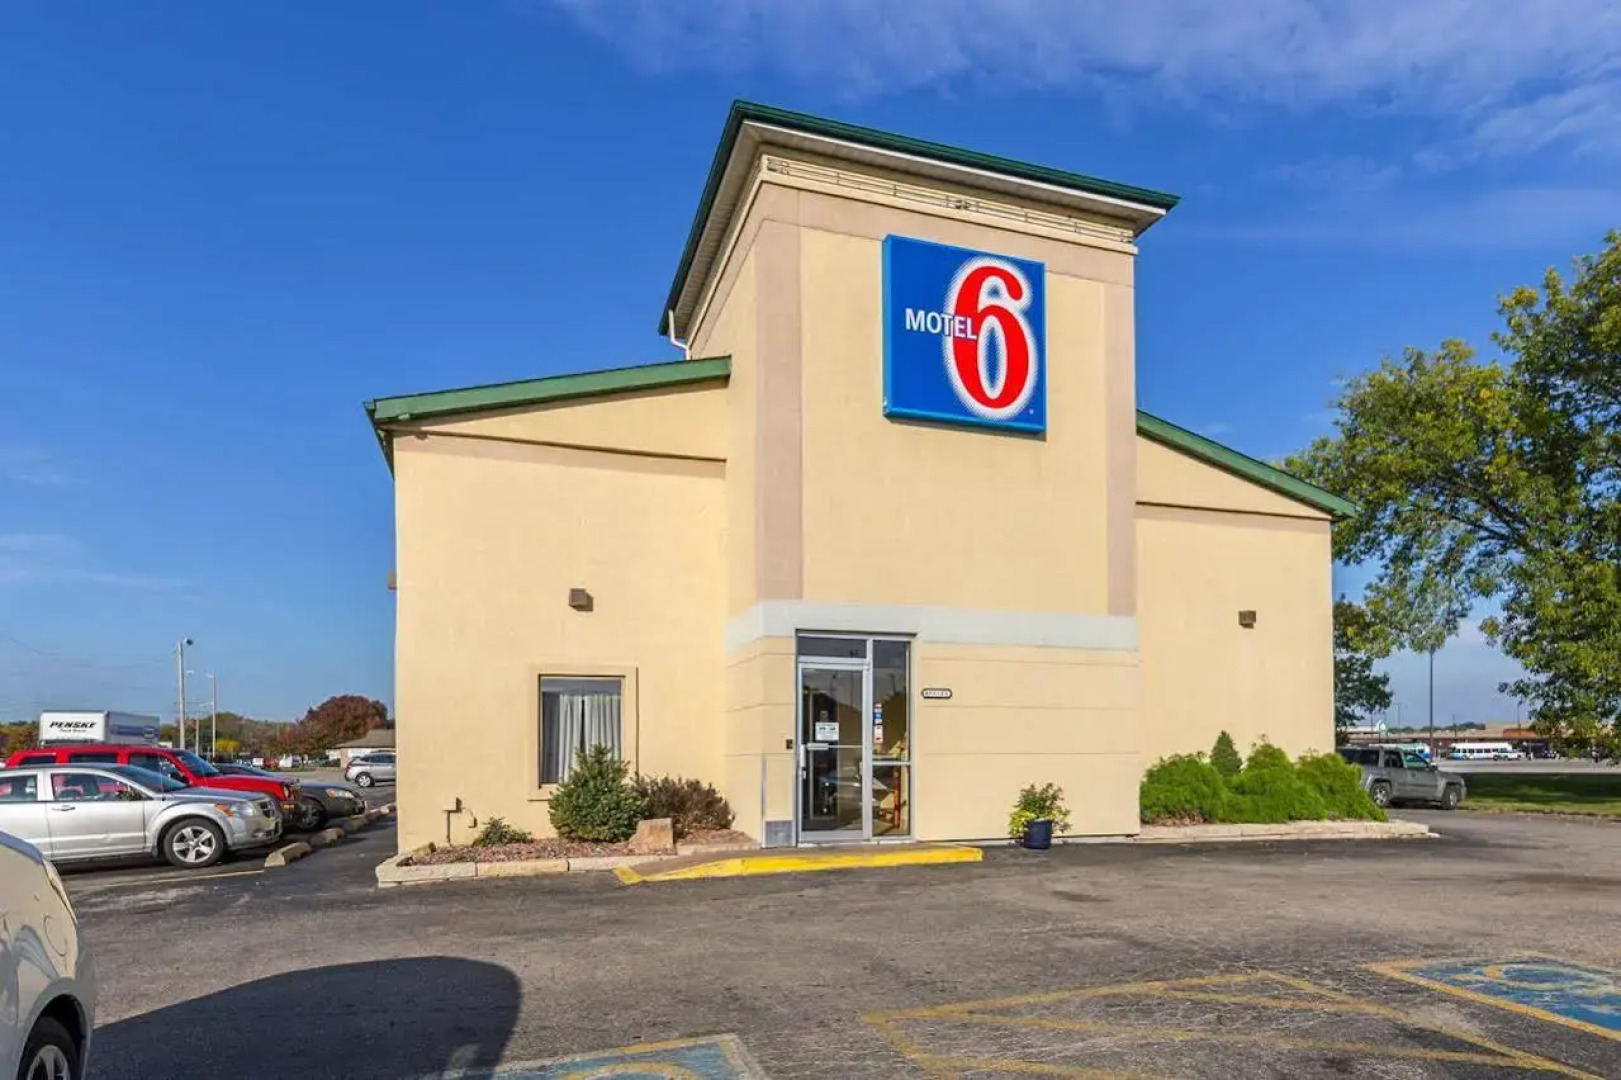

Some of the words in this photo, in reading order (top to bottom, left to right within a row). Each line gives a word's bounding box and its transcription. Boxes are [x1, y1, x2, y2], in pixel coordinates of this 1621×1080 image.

[905, 308, 978, 340] MOTEL
[951, 265, 1030, 410] 6
[49, 721, 97, 729] PENSKE
